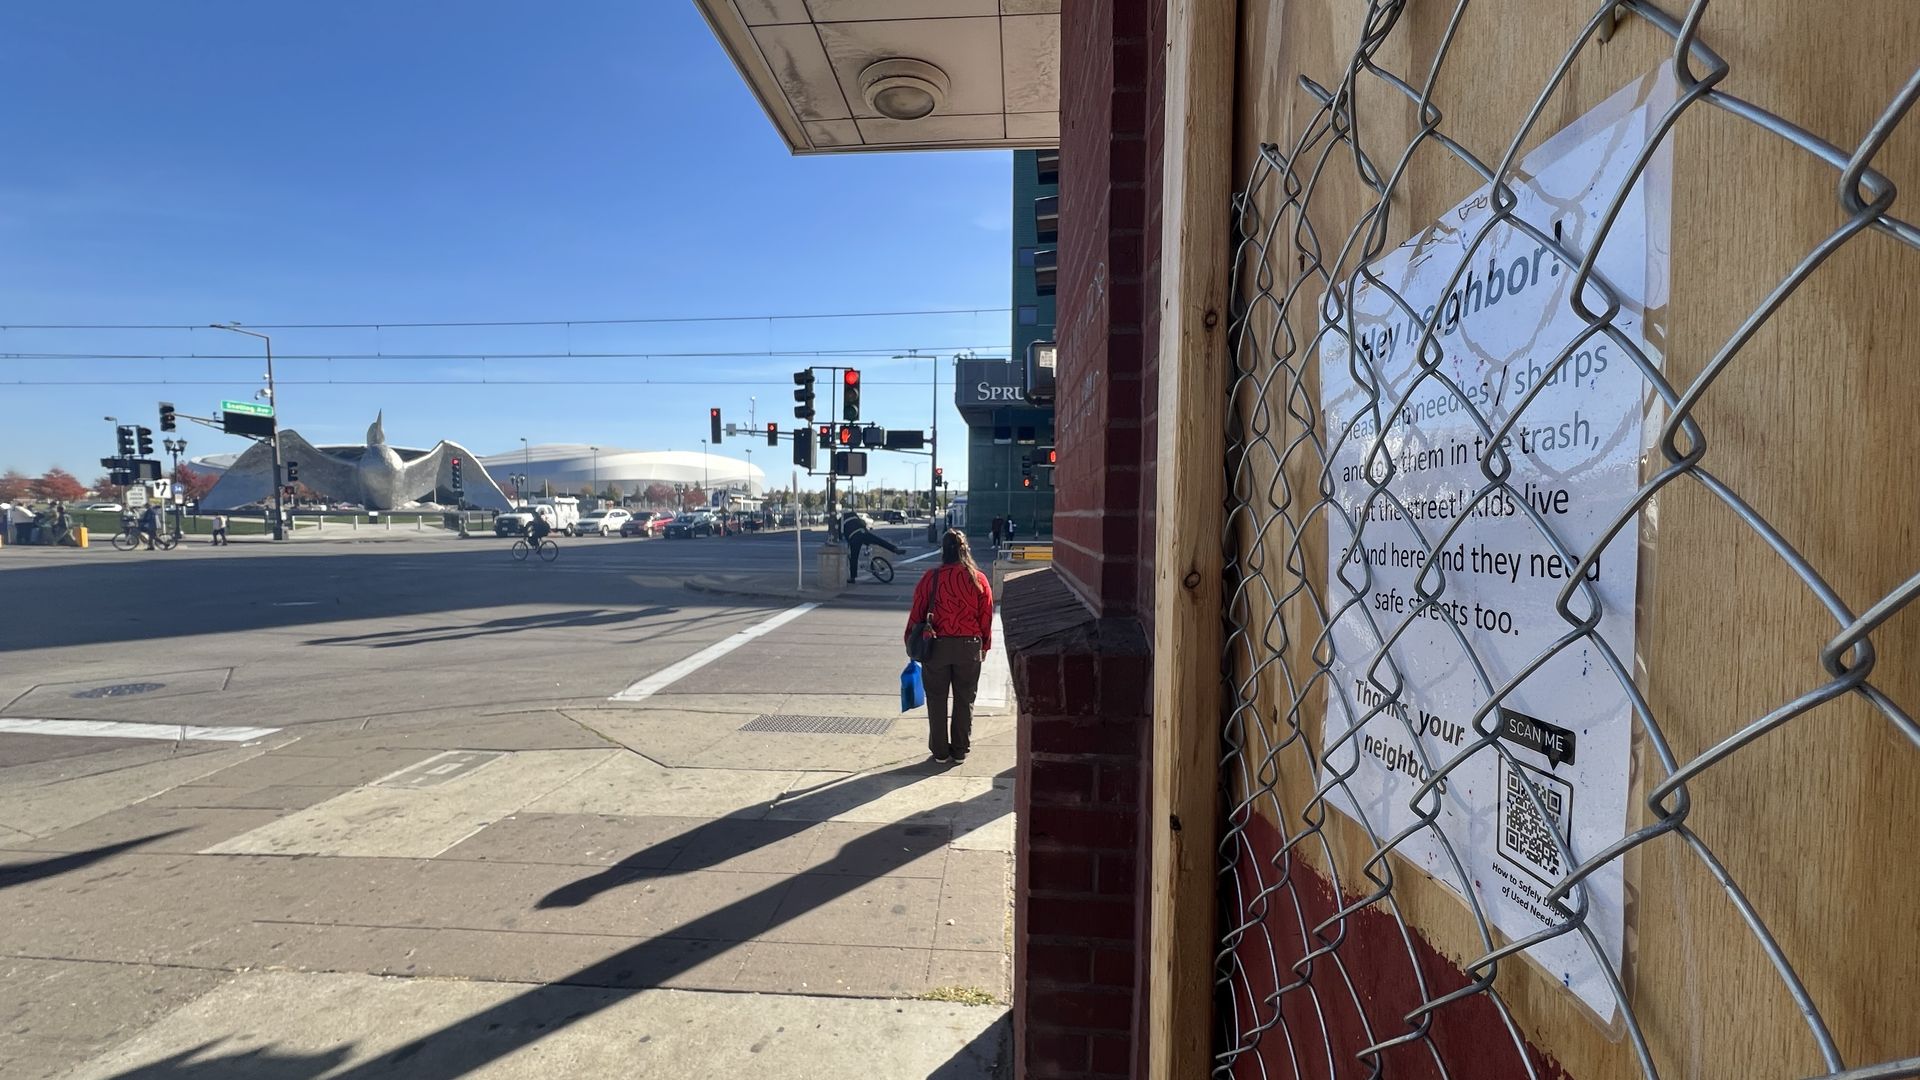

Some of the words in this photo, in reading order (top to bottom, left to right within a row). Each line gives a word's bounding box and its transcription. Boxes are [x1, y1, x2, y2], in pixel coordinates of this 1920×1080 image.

[1361, 322, 1401, 364] Hey
[1415, 377, 1489, 422] needles
[1402, 446, 1444, 474] them
[1450, 439, 1467, 466] in
[1519, 411, 1600, 455] trash,
[1354, 502, 1376, 523] nt
[1407, 489, 1463, 520] street!
[1524, 482, 1569, 515] live
[1341, 541, 1387, 567] aound
[1391, 541, 1426, 569] here
[1436, 542, 1464, 573] nd
[1471, 543, 1522, 584] they
[1374, 588, 1404, 614] safe
[1474, 603, 1519, 636] too.
[1418, 709, 1466, 747] your
[1509, 718, 1542, 744] SCAN
[1544, 730, 1565, 753] ME
[1364, 733, 1448, 796] neighbos
[1492, 861, 1509, 880] How
[1509, 873, 1518, 886] to
[1518, 879, 1542, 904] Safely
[1501, 886, 1511, 898] of
[1510, 890, 1530, 911] Used
